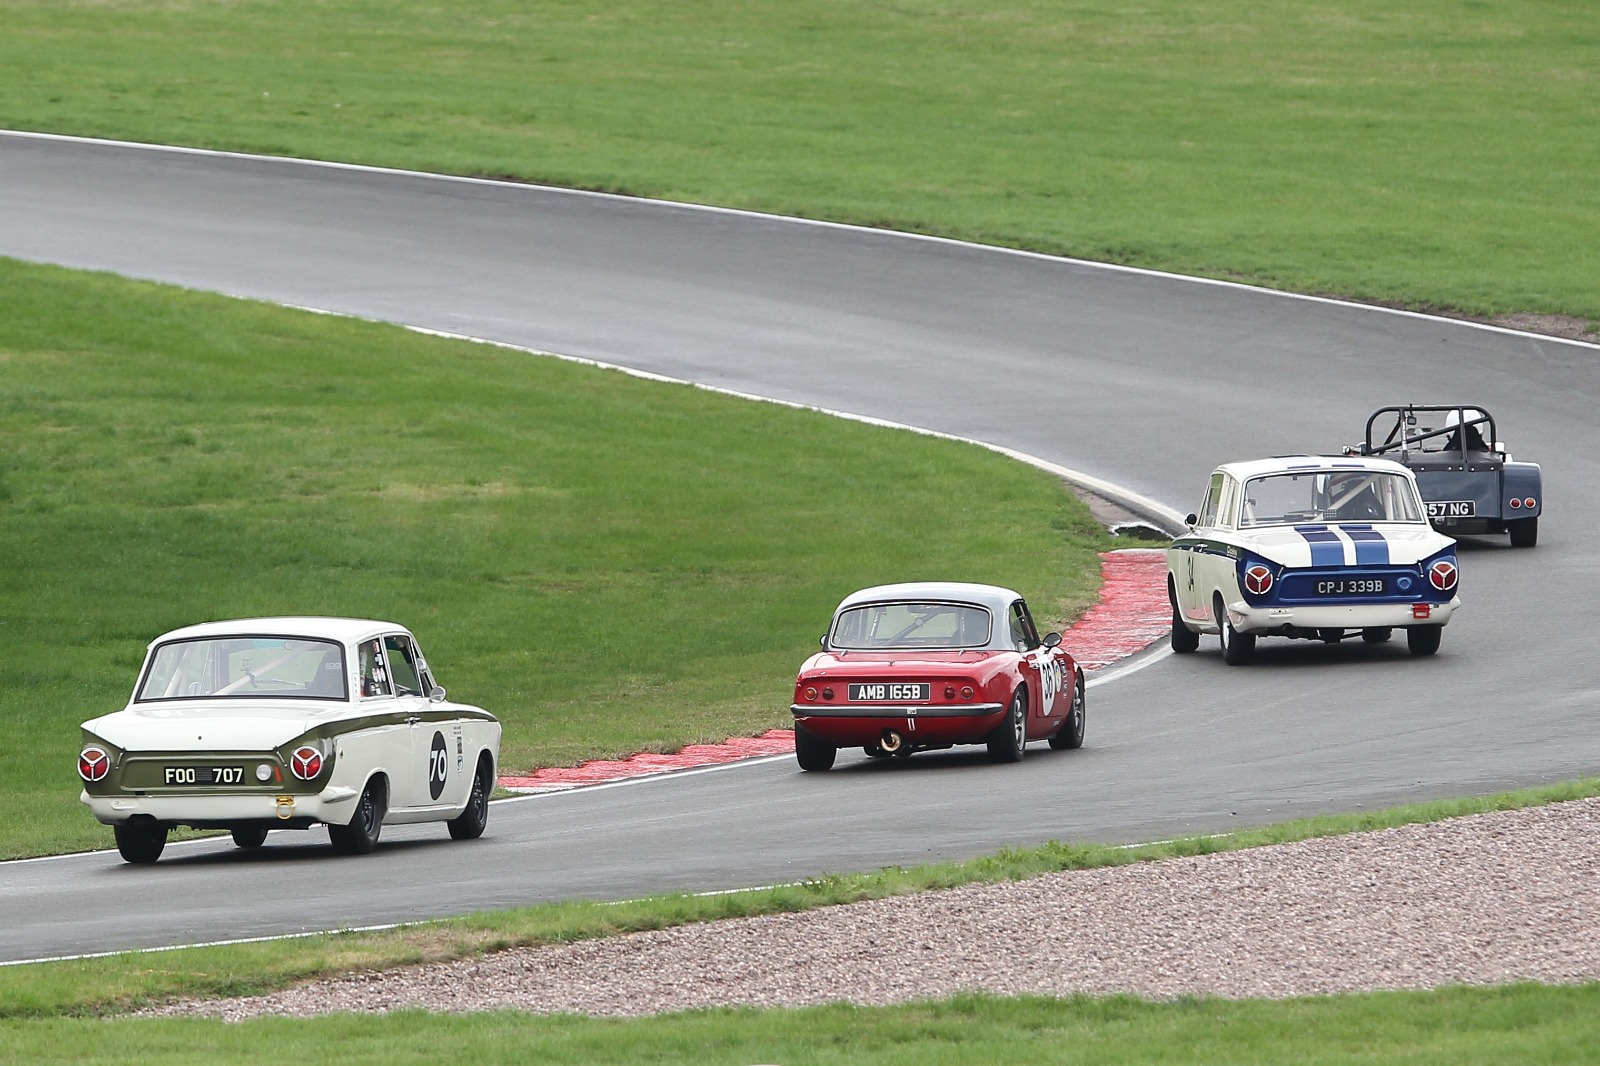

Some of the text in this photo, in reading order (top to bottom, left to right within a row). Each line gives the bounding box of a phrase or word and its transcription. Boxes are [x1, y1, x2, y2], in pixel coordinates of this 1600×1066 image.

[1450, 502, 1469, 515] NG
[1318, 580, 1383, 594] CPJ 339B
[858, 684, 921, 700] AMB 165B
[430, 748, 447, 782] 70
[165, 767, 243, 784] FOO 707
